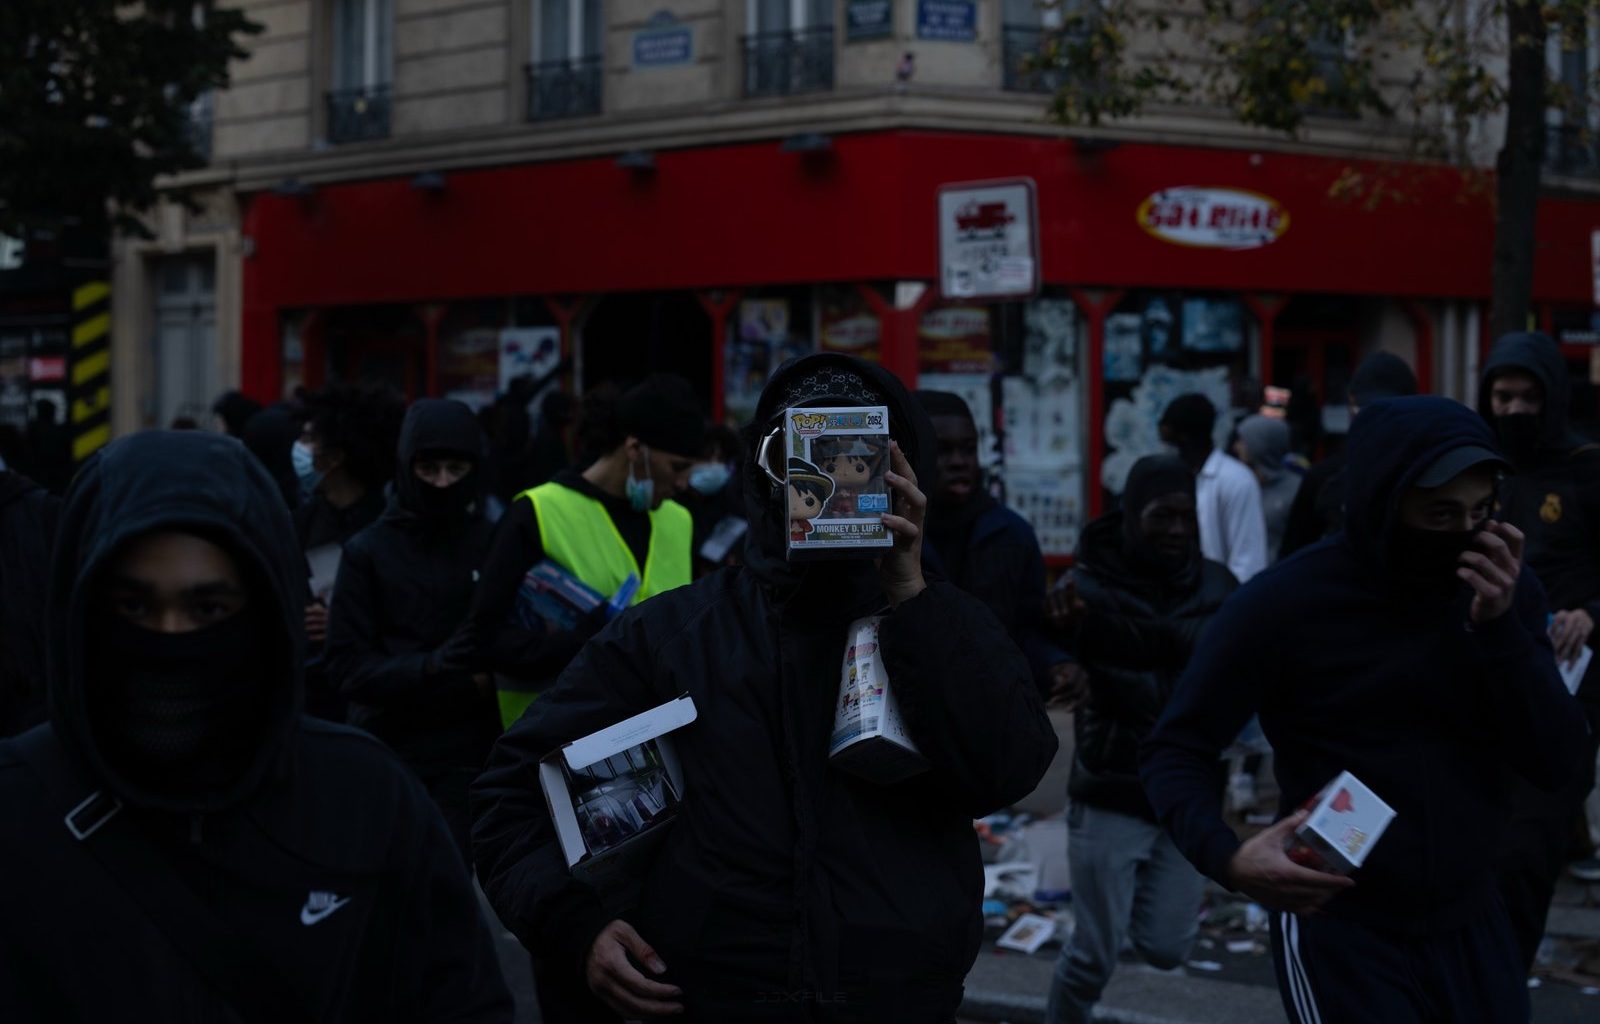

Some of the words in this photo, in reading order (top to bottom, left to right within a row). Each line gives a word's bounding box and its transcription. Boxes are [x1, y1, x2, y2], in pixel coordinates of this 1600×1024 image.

[791, 414, 827, 429] POP!
[867, 415, 882, 425] 2052
[816, 524, 850, 533] MONKEY
[851, 524, 860, 533] D.
[861, 524, 885, 533] LUFFY
